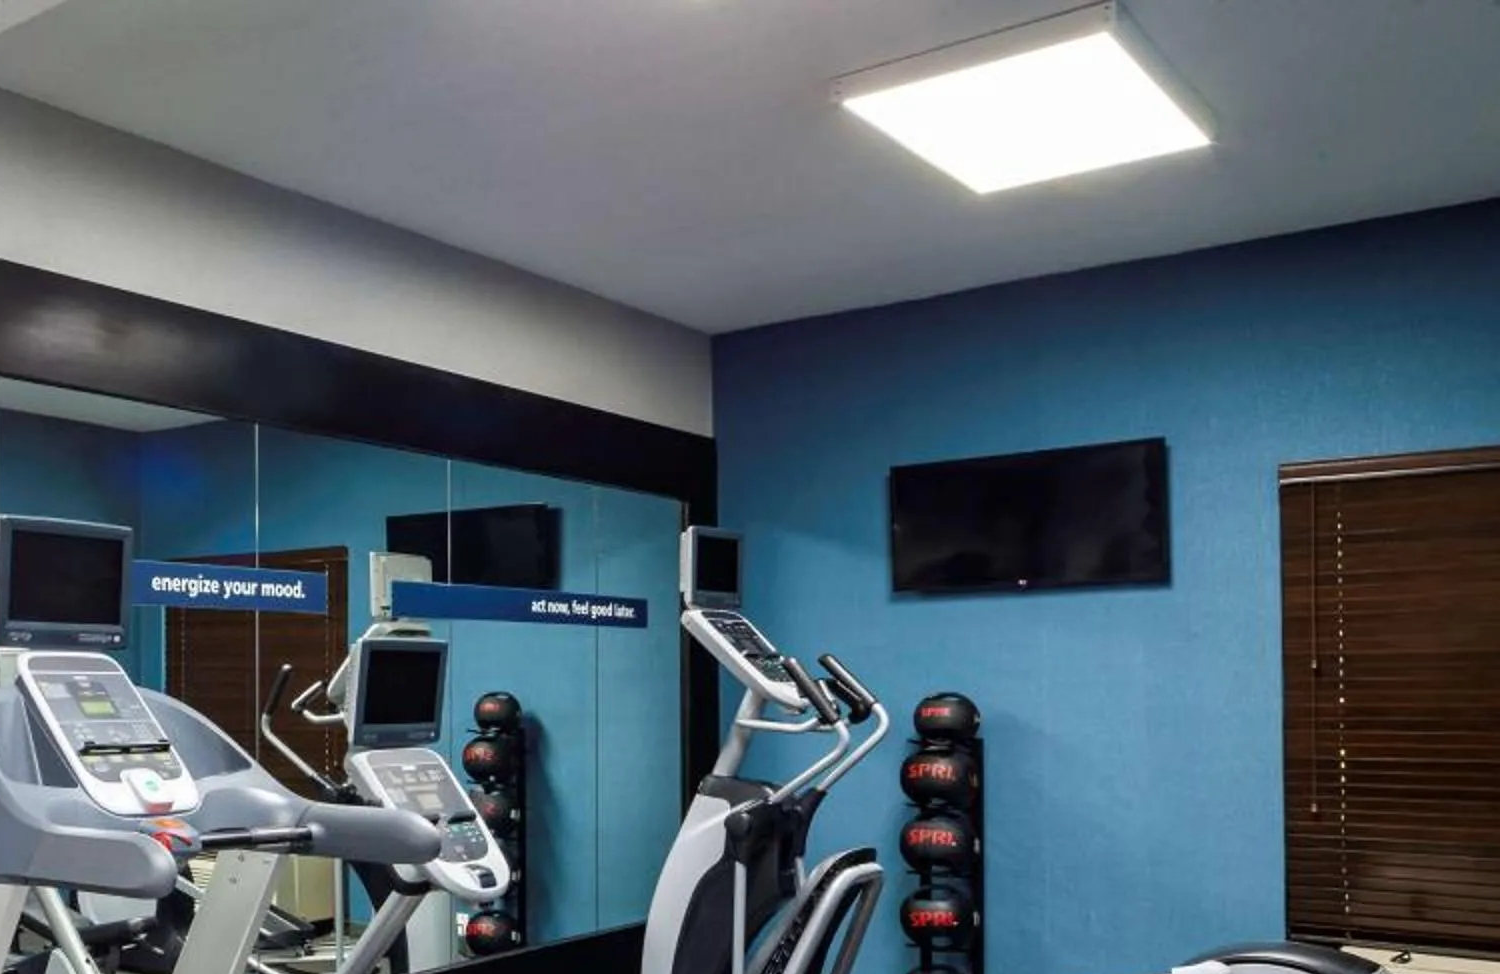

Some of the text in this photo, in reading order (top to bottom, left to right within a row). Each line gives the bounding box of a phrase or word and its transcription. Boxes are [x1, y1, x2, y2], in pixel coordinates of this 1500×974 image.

[151, 574, 306, 599] energize your mood.
[531, 600, 546, 613] act
[547, 601, 570, 615] now,
[572, 600, 589, 615] feel
[591, 602, 613, 619] good
